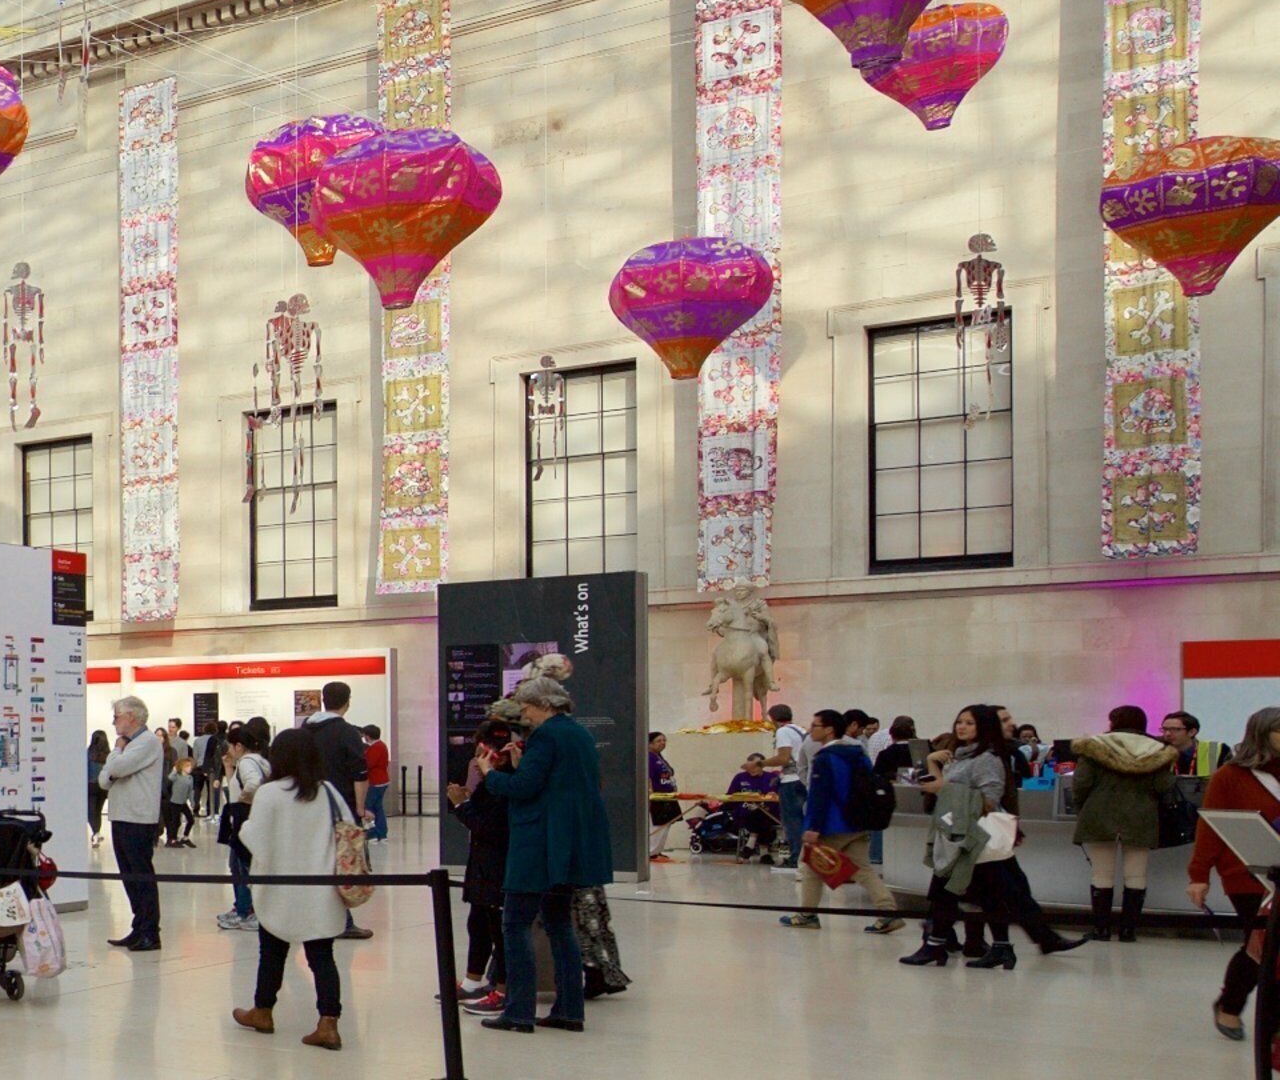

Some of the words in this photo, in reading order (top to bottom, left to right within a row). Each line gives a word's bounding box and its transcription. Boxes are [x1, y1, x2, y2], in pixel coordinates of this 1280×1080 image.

[577, 583, 589, 601] on
[573, 604, 589, 655] What's
[235, 666, 266, 675] Tickets
